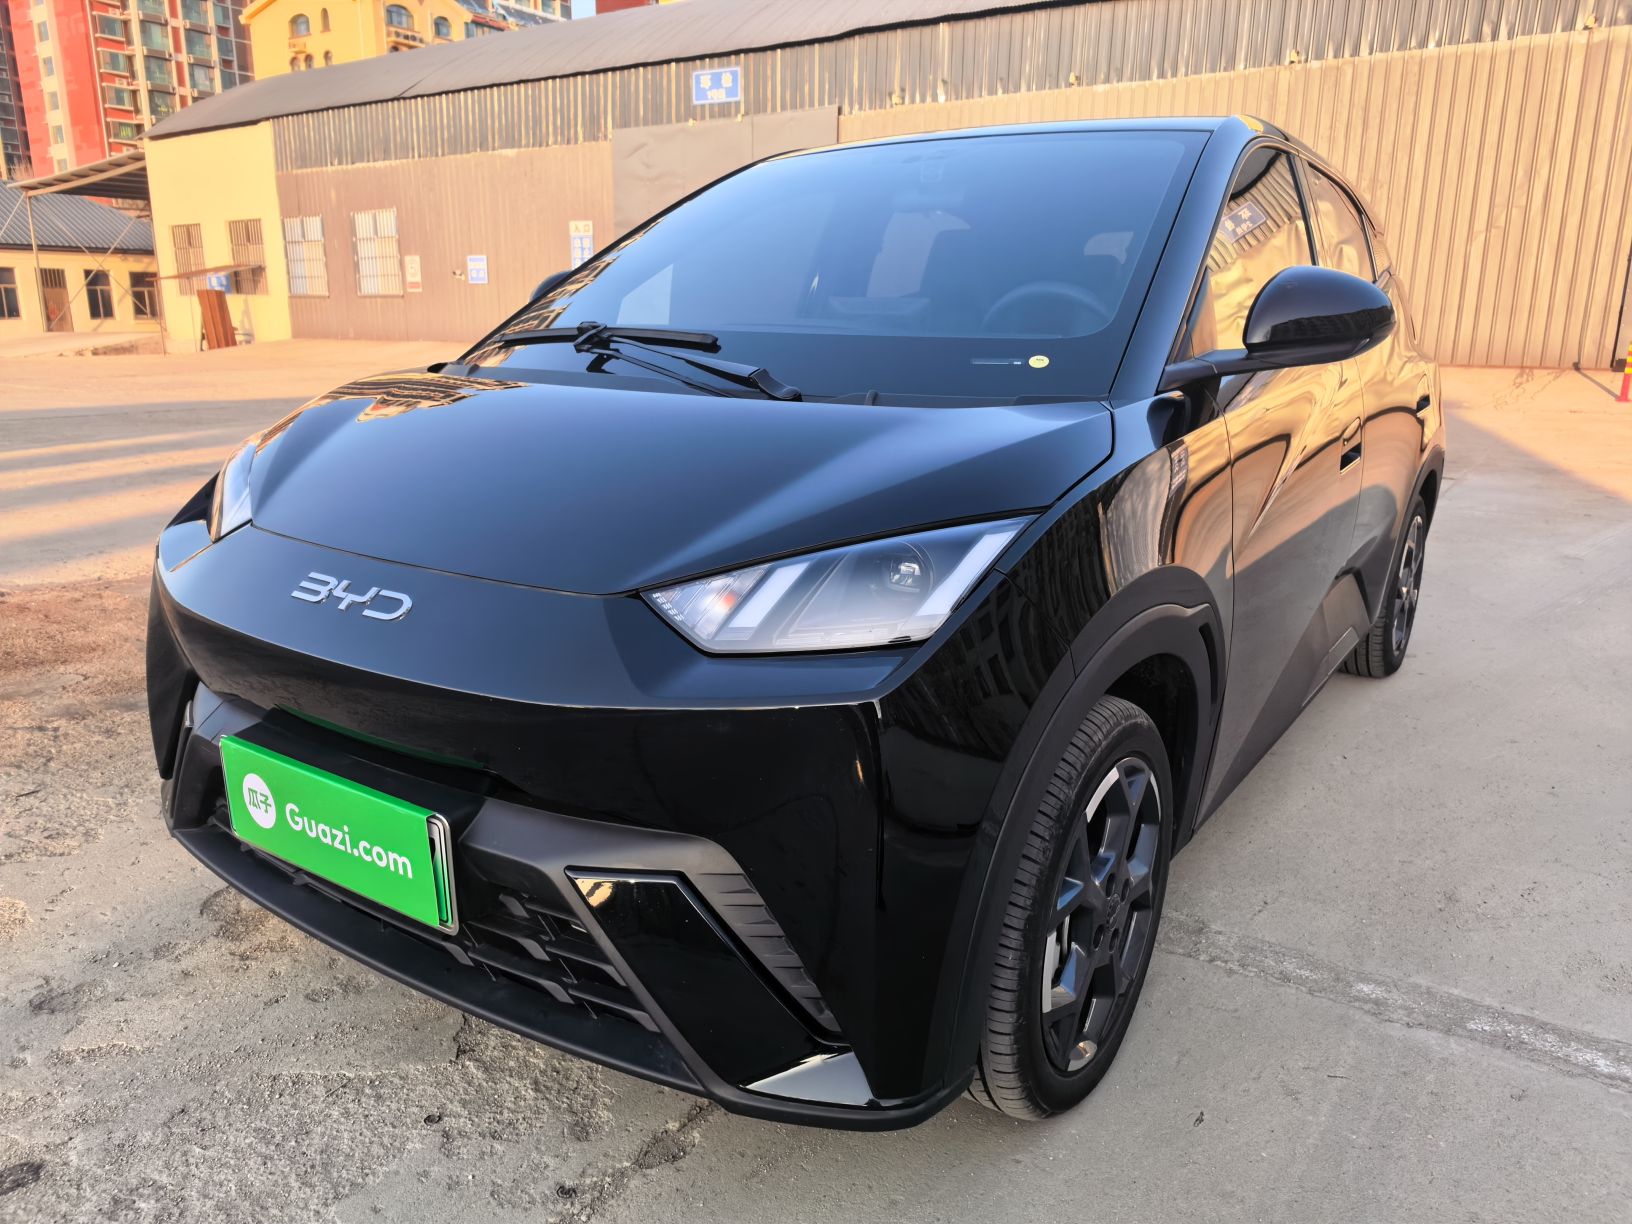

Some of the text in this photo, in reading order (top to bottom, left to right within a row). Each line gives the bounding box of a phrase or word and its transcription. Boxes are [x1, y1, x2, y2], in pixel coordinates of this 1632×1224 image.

[290, 571, 413, 621] BYD
[247, 787, 272, 814] 瓜子
[285, 802, 413, 879] Guazi.com
